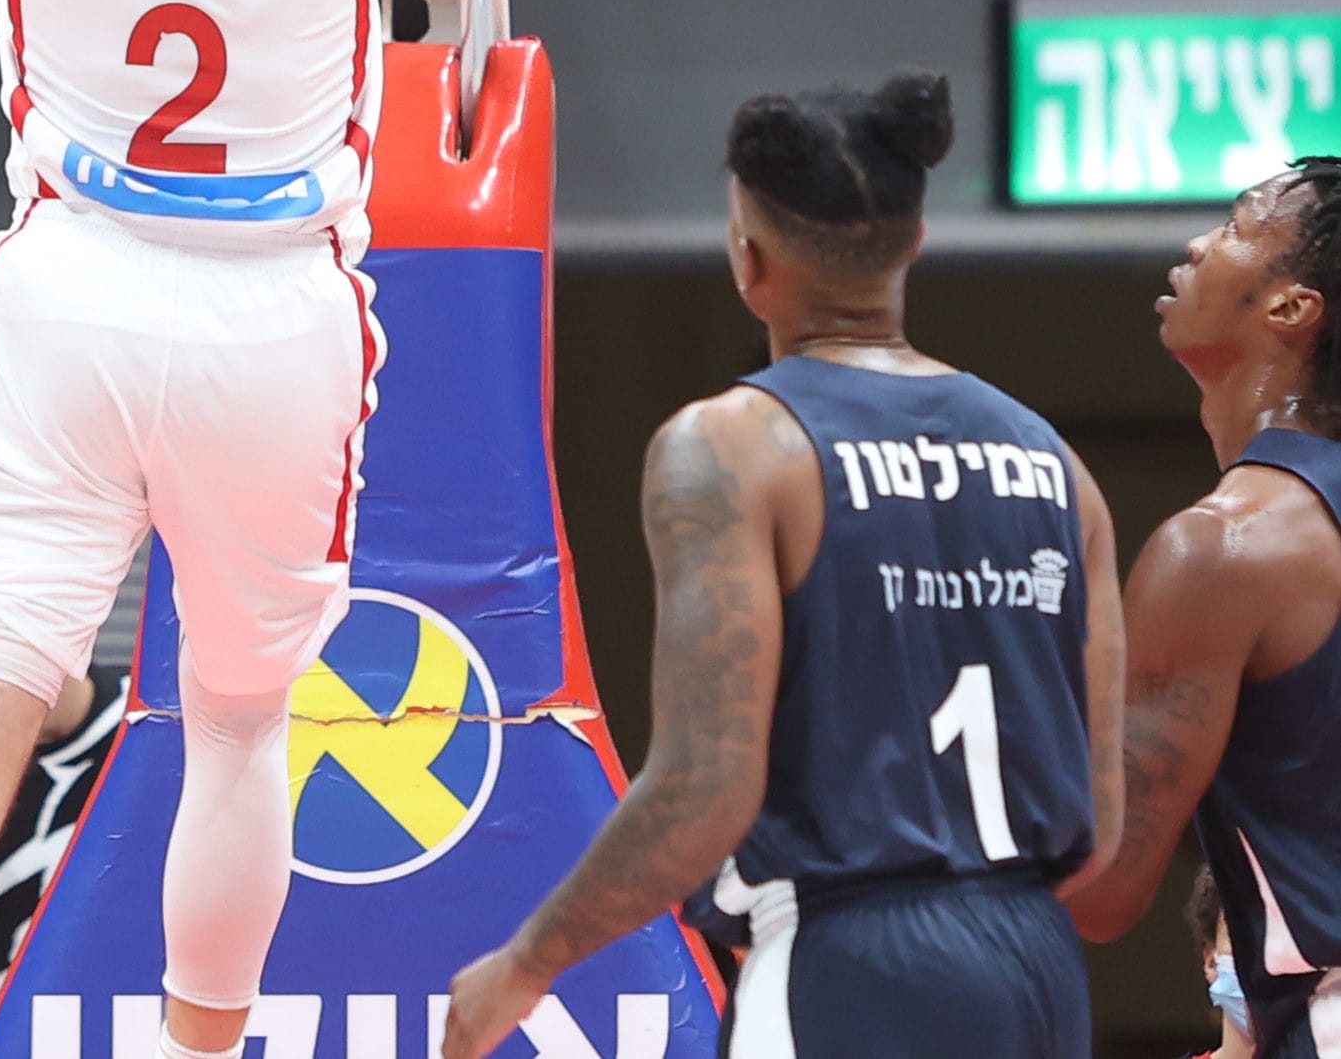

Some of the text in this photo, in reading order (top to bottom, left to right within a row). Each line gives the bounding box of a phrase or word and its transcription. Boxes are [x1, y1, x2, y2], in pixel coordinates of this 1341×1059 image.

[125, 2, 227, 174] 2
[1033, 36, 1335, 193] יציאה
[833, 434, 1069, 510] המילטון
[915, 556, 1035, 609] מלונות
[929, 663, 1020, 863] 1
